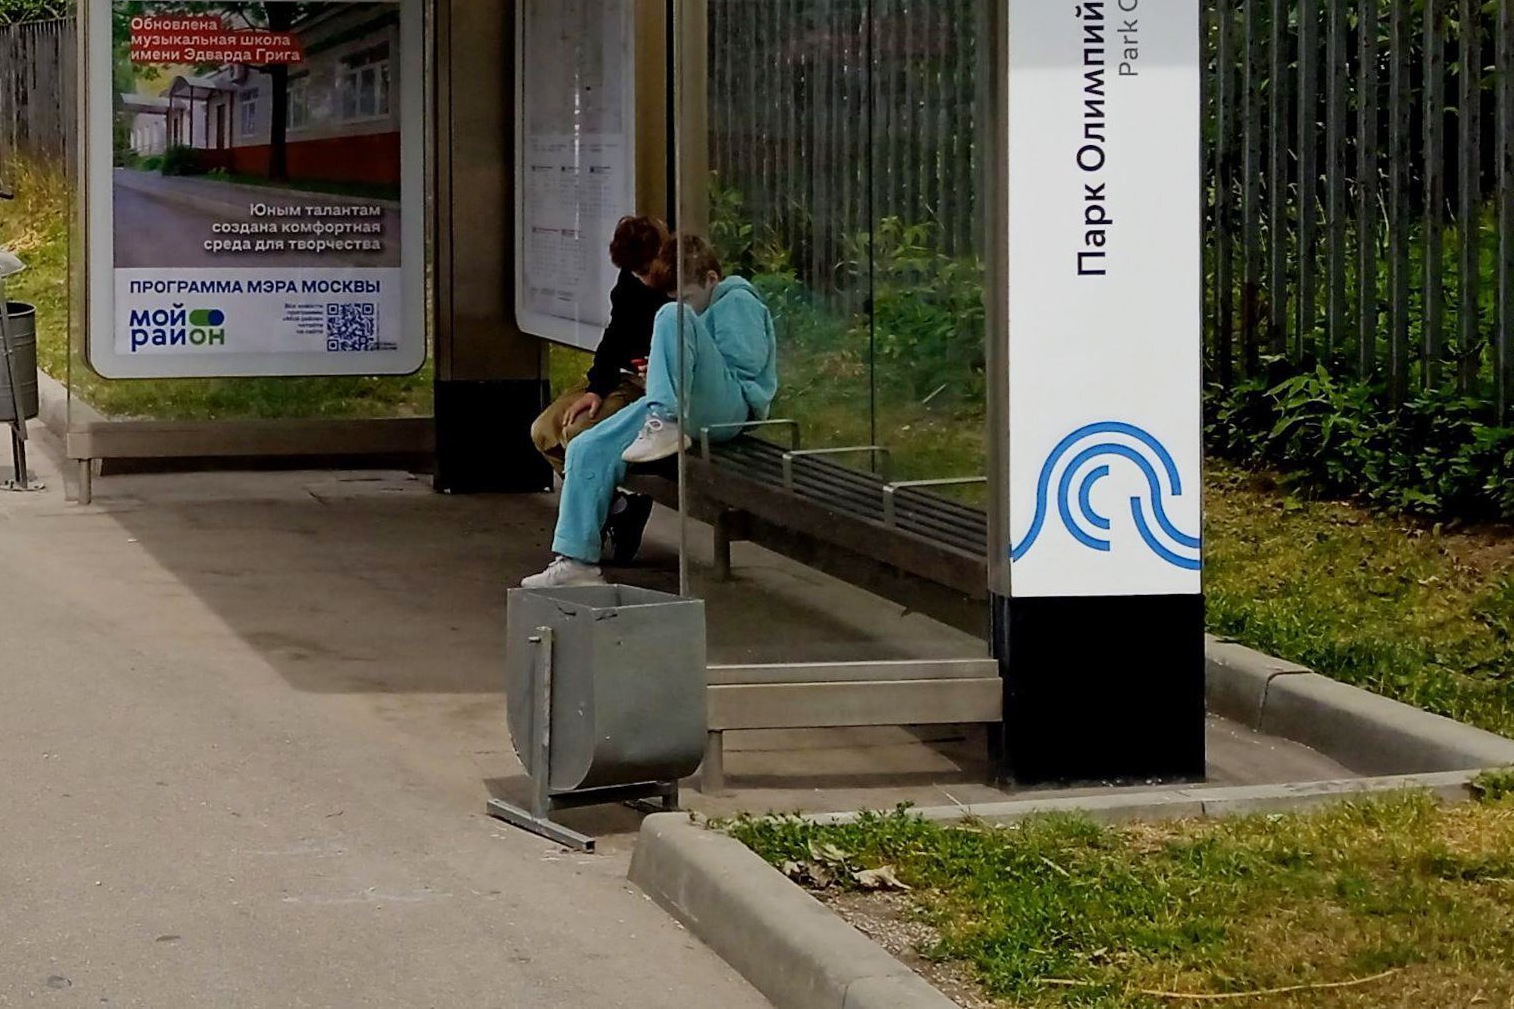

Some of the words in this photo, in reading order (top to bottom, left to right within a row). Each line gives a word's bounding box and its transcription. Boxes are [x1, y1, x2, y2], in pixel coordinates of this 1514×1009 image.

[131, 17, 217, 31] Обновлена
[131, 34, 236, 47] музыкальная
[240, 34, 290, 46] школа
[1119, 19, 1139, 76] Park
[131, 50, 179, 61] имени
[184, 49, 252, 63] Эдварда
[256, 49, 300, 63] Грига
[250, 203, 301, 217] Юным
[306, 205, 380, 216] талантам
[212, 222, 277, 235] создана
[282, 221, 380, 236] комфортная
[1078, 183, 1113, 275] Парк
[204, 239, 251, 253] среда
[255, 240, 284, 253] для
[289, 239, 380, 251] творчества
[130, 280, 244, 293] ПРОГРАММА
[248, 280, 297, 293] МЭРА
[301, 280, 380, 293] МОСКВЫ
[130, 303, 186, 327] мой
